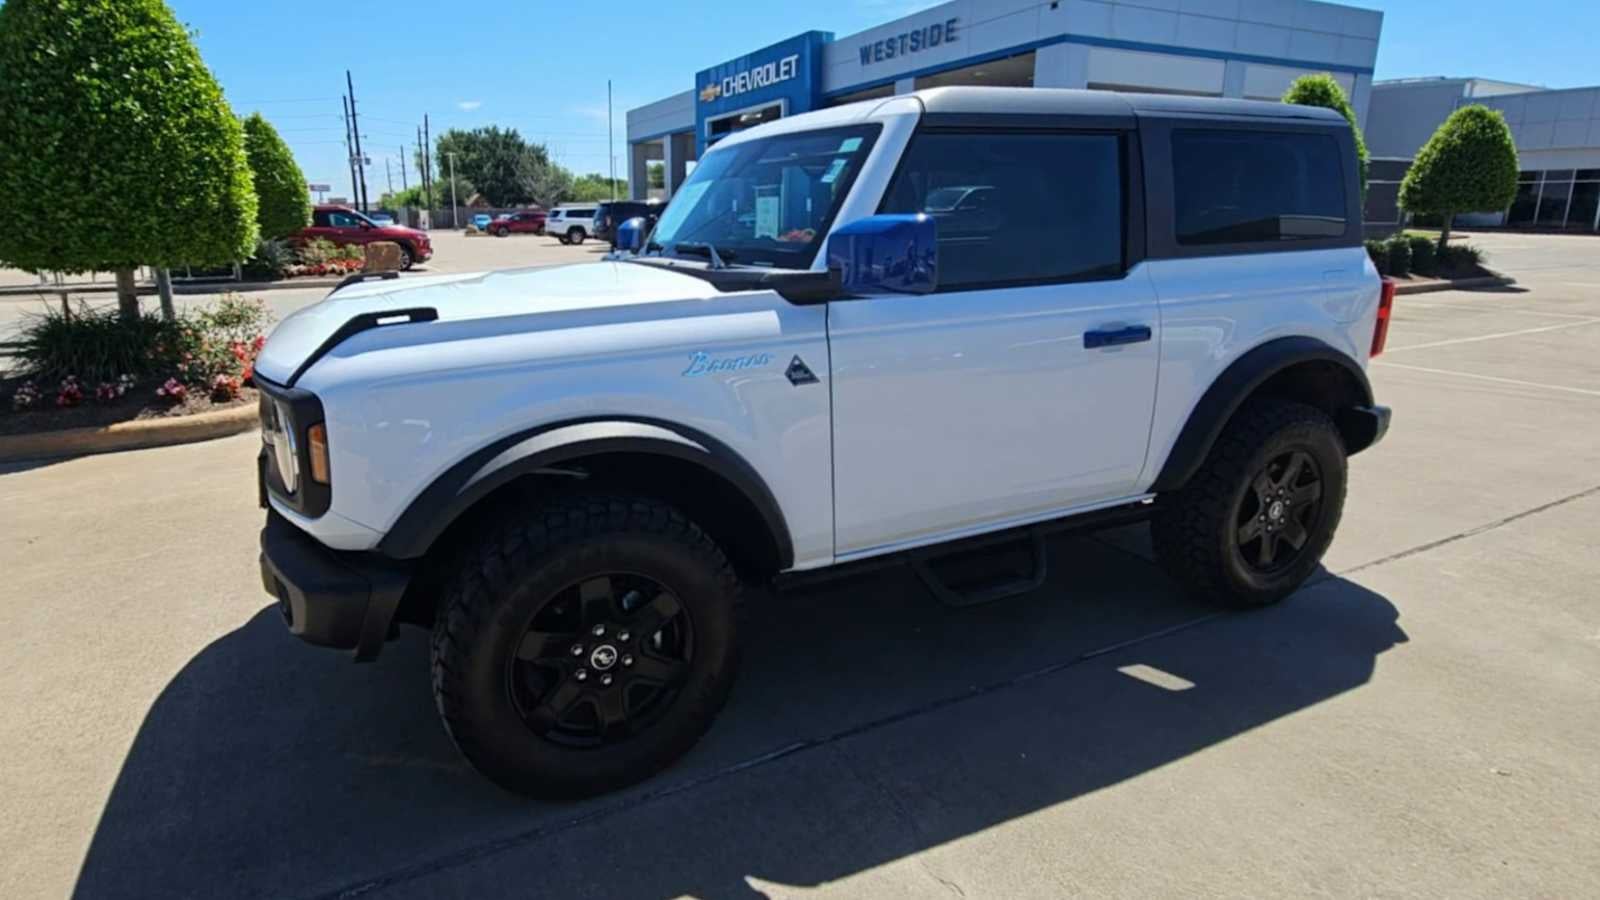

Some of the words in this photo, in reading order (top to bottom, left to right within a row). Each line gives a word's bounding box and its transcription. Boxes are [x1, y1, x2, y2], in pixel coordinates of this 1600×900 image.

[859, 18, 958, 66] WESTSIDE
[722, 55, 799, 97] CHEVROLET
[682, 351, 775, 377] Bronco
